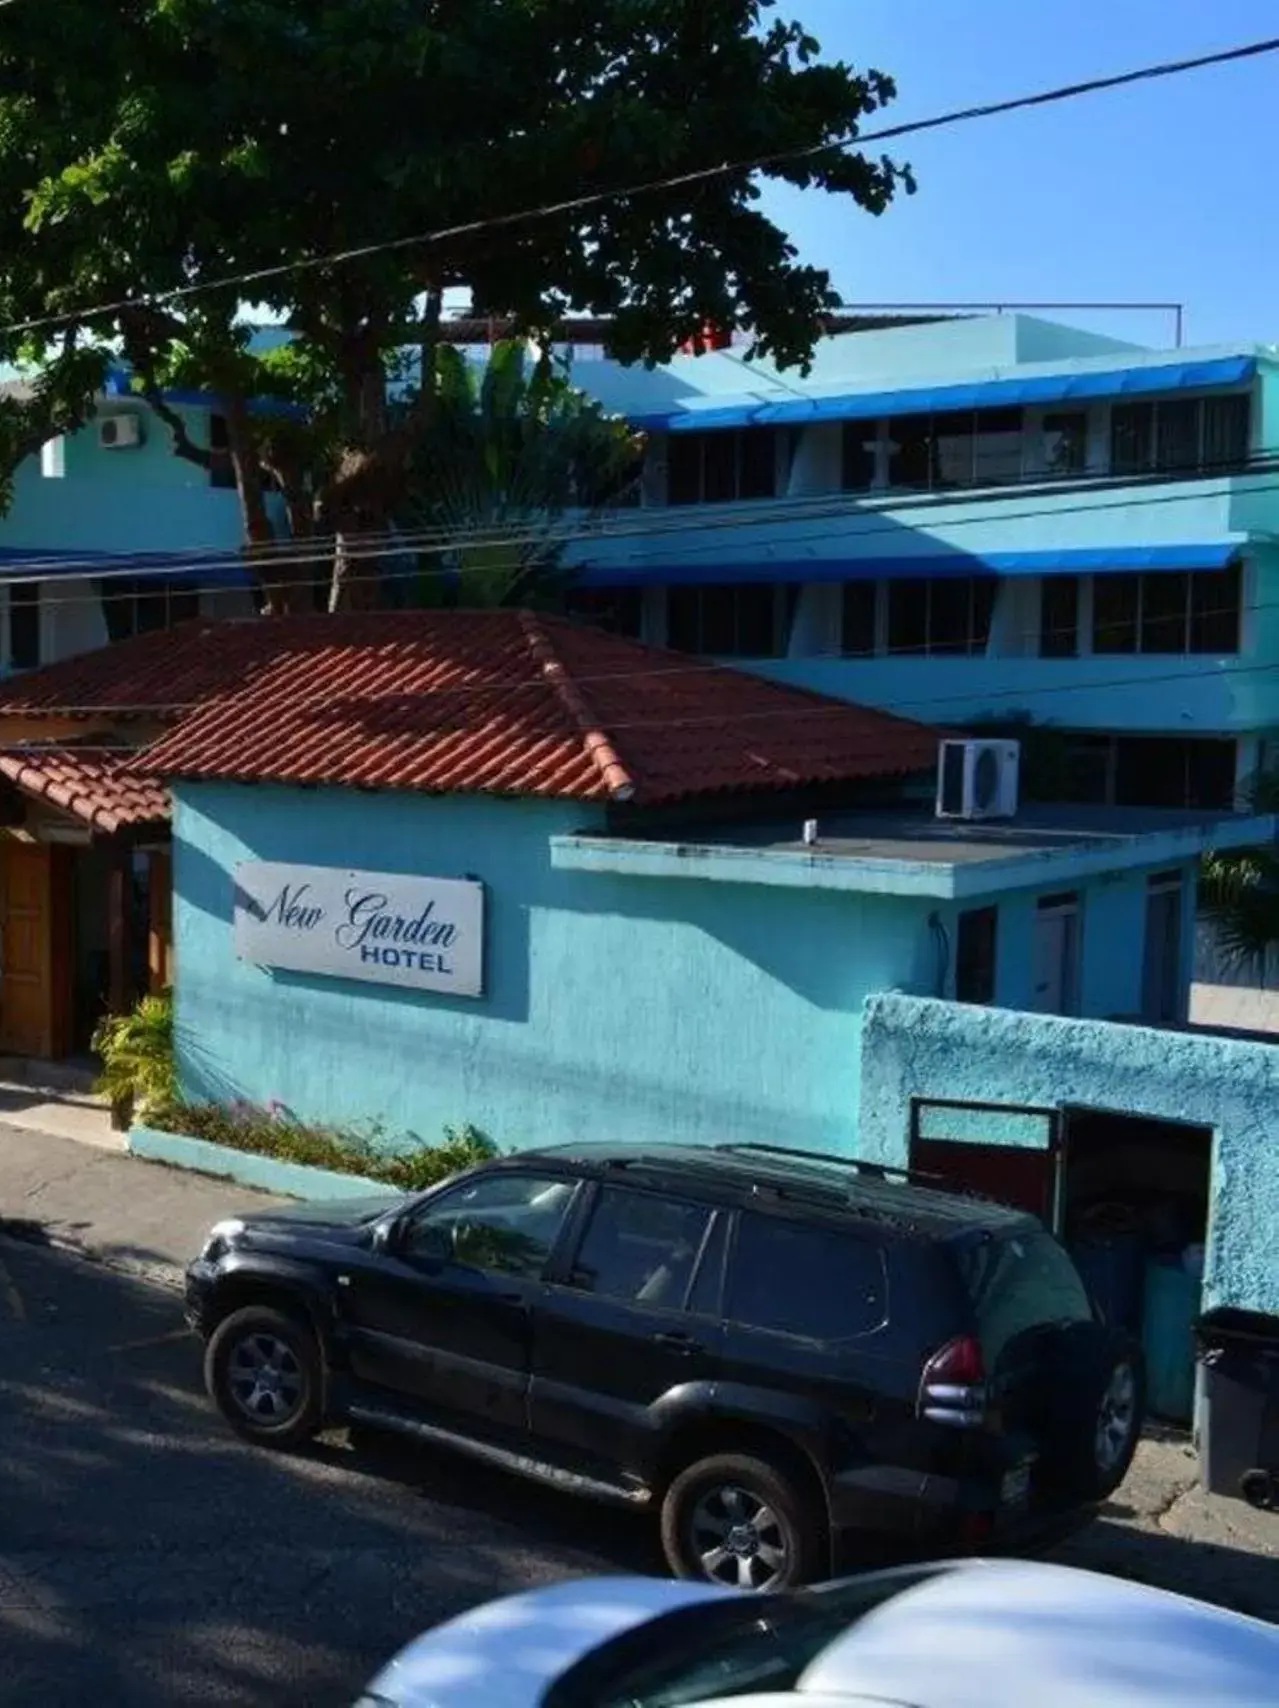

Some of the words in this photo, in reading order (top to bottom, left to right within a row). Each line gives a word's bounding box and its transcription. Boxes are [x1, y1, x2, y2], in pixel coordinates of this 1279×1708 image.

[254, 884, 326, 930] New
[335, 888, 456, 949] Garden
[361, 945, 452, 973] HOTEL
